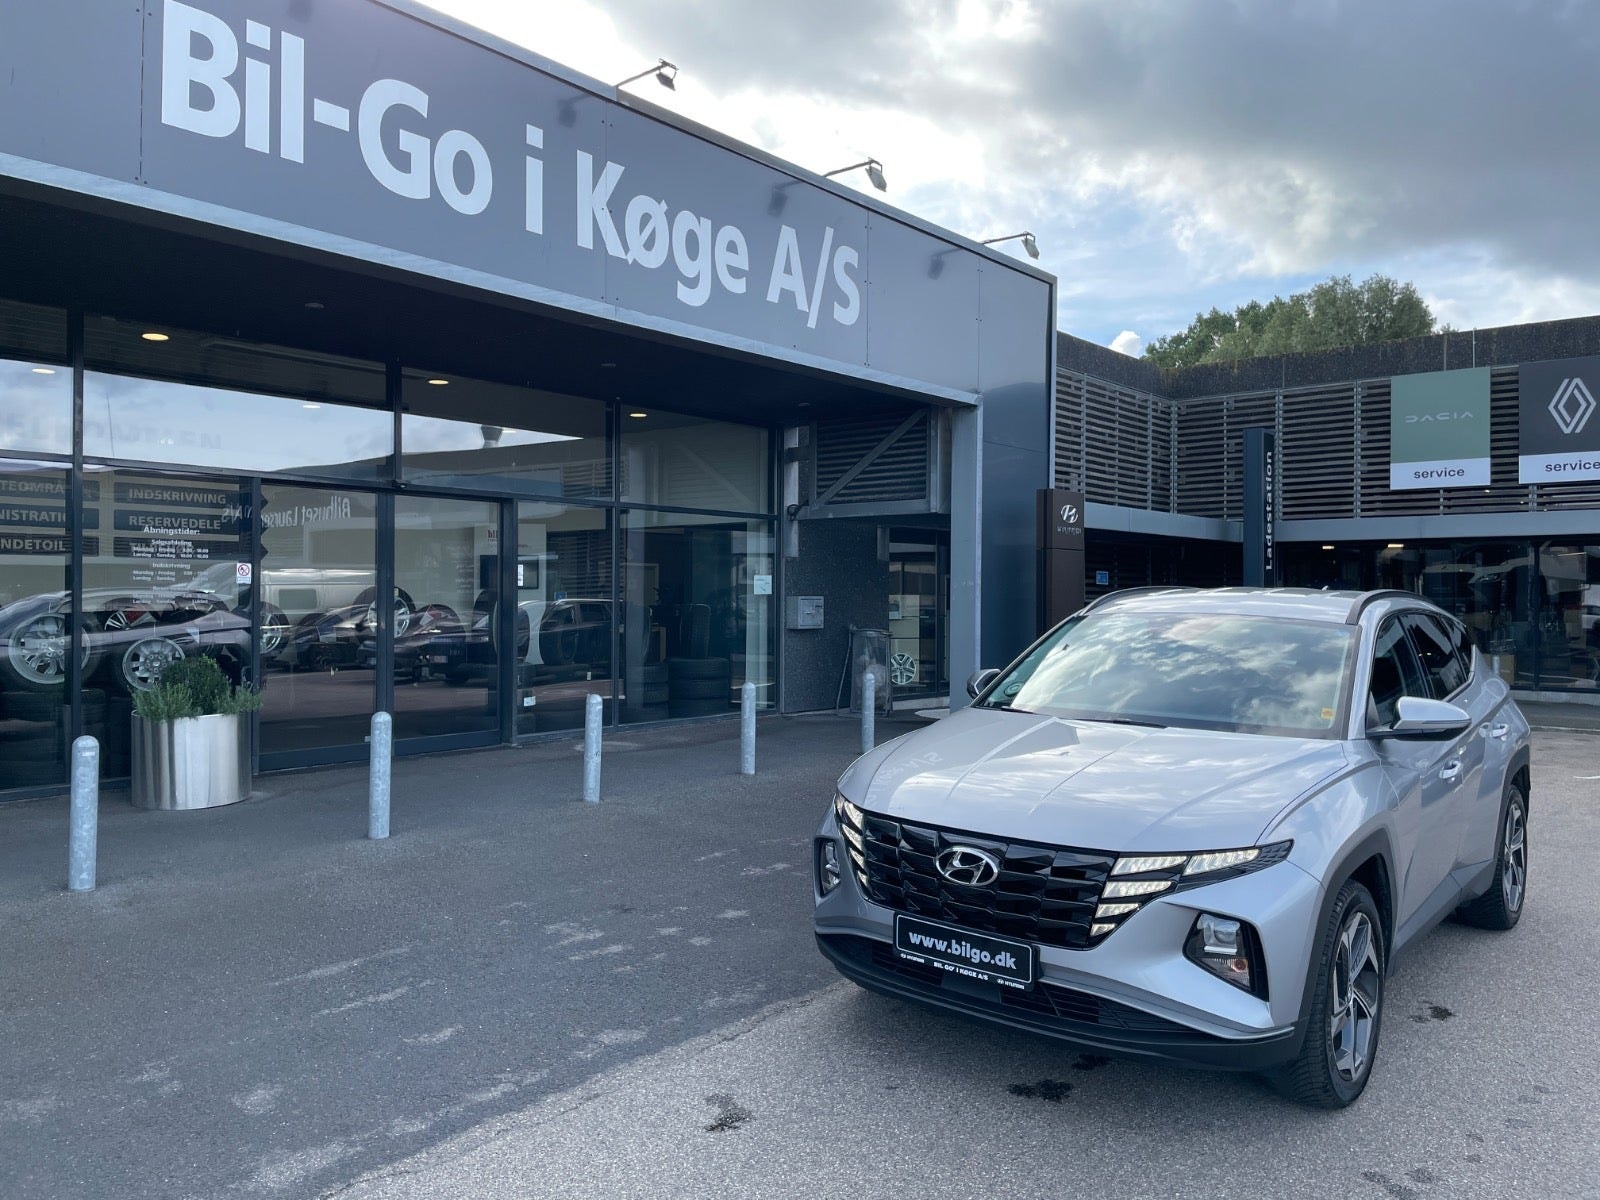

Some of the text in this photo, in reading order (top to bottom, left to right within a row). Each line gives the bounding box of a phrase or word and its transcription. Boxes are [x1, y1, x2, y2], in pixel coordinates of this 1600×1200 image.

[161, 0, 860, 329] Bil-Go i Køge A/S
[1405, 411, 1474, 423] DACIA
[1545, 459, 1600, 472] service
[1414, 467, 1465, 479] service
[128, 489, 226, 504] INDSKRIVNING
[128, 515, 221, 530] RESERVEDELE
[143, 525, 200, 536] Åbningstider:
[909, 932, 1017, 970] www.bilgo.dk
